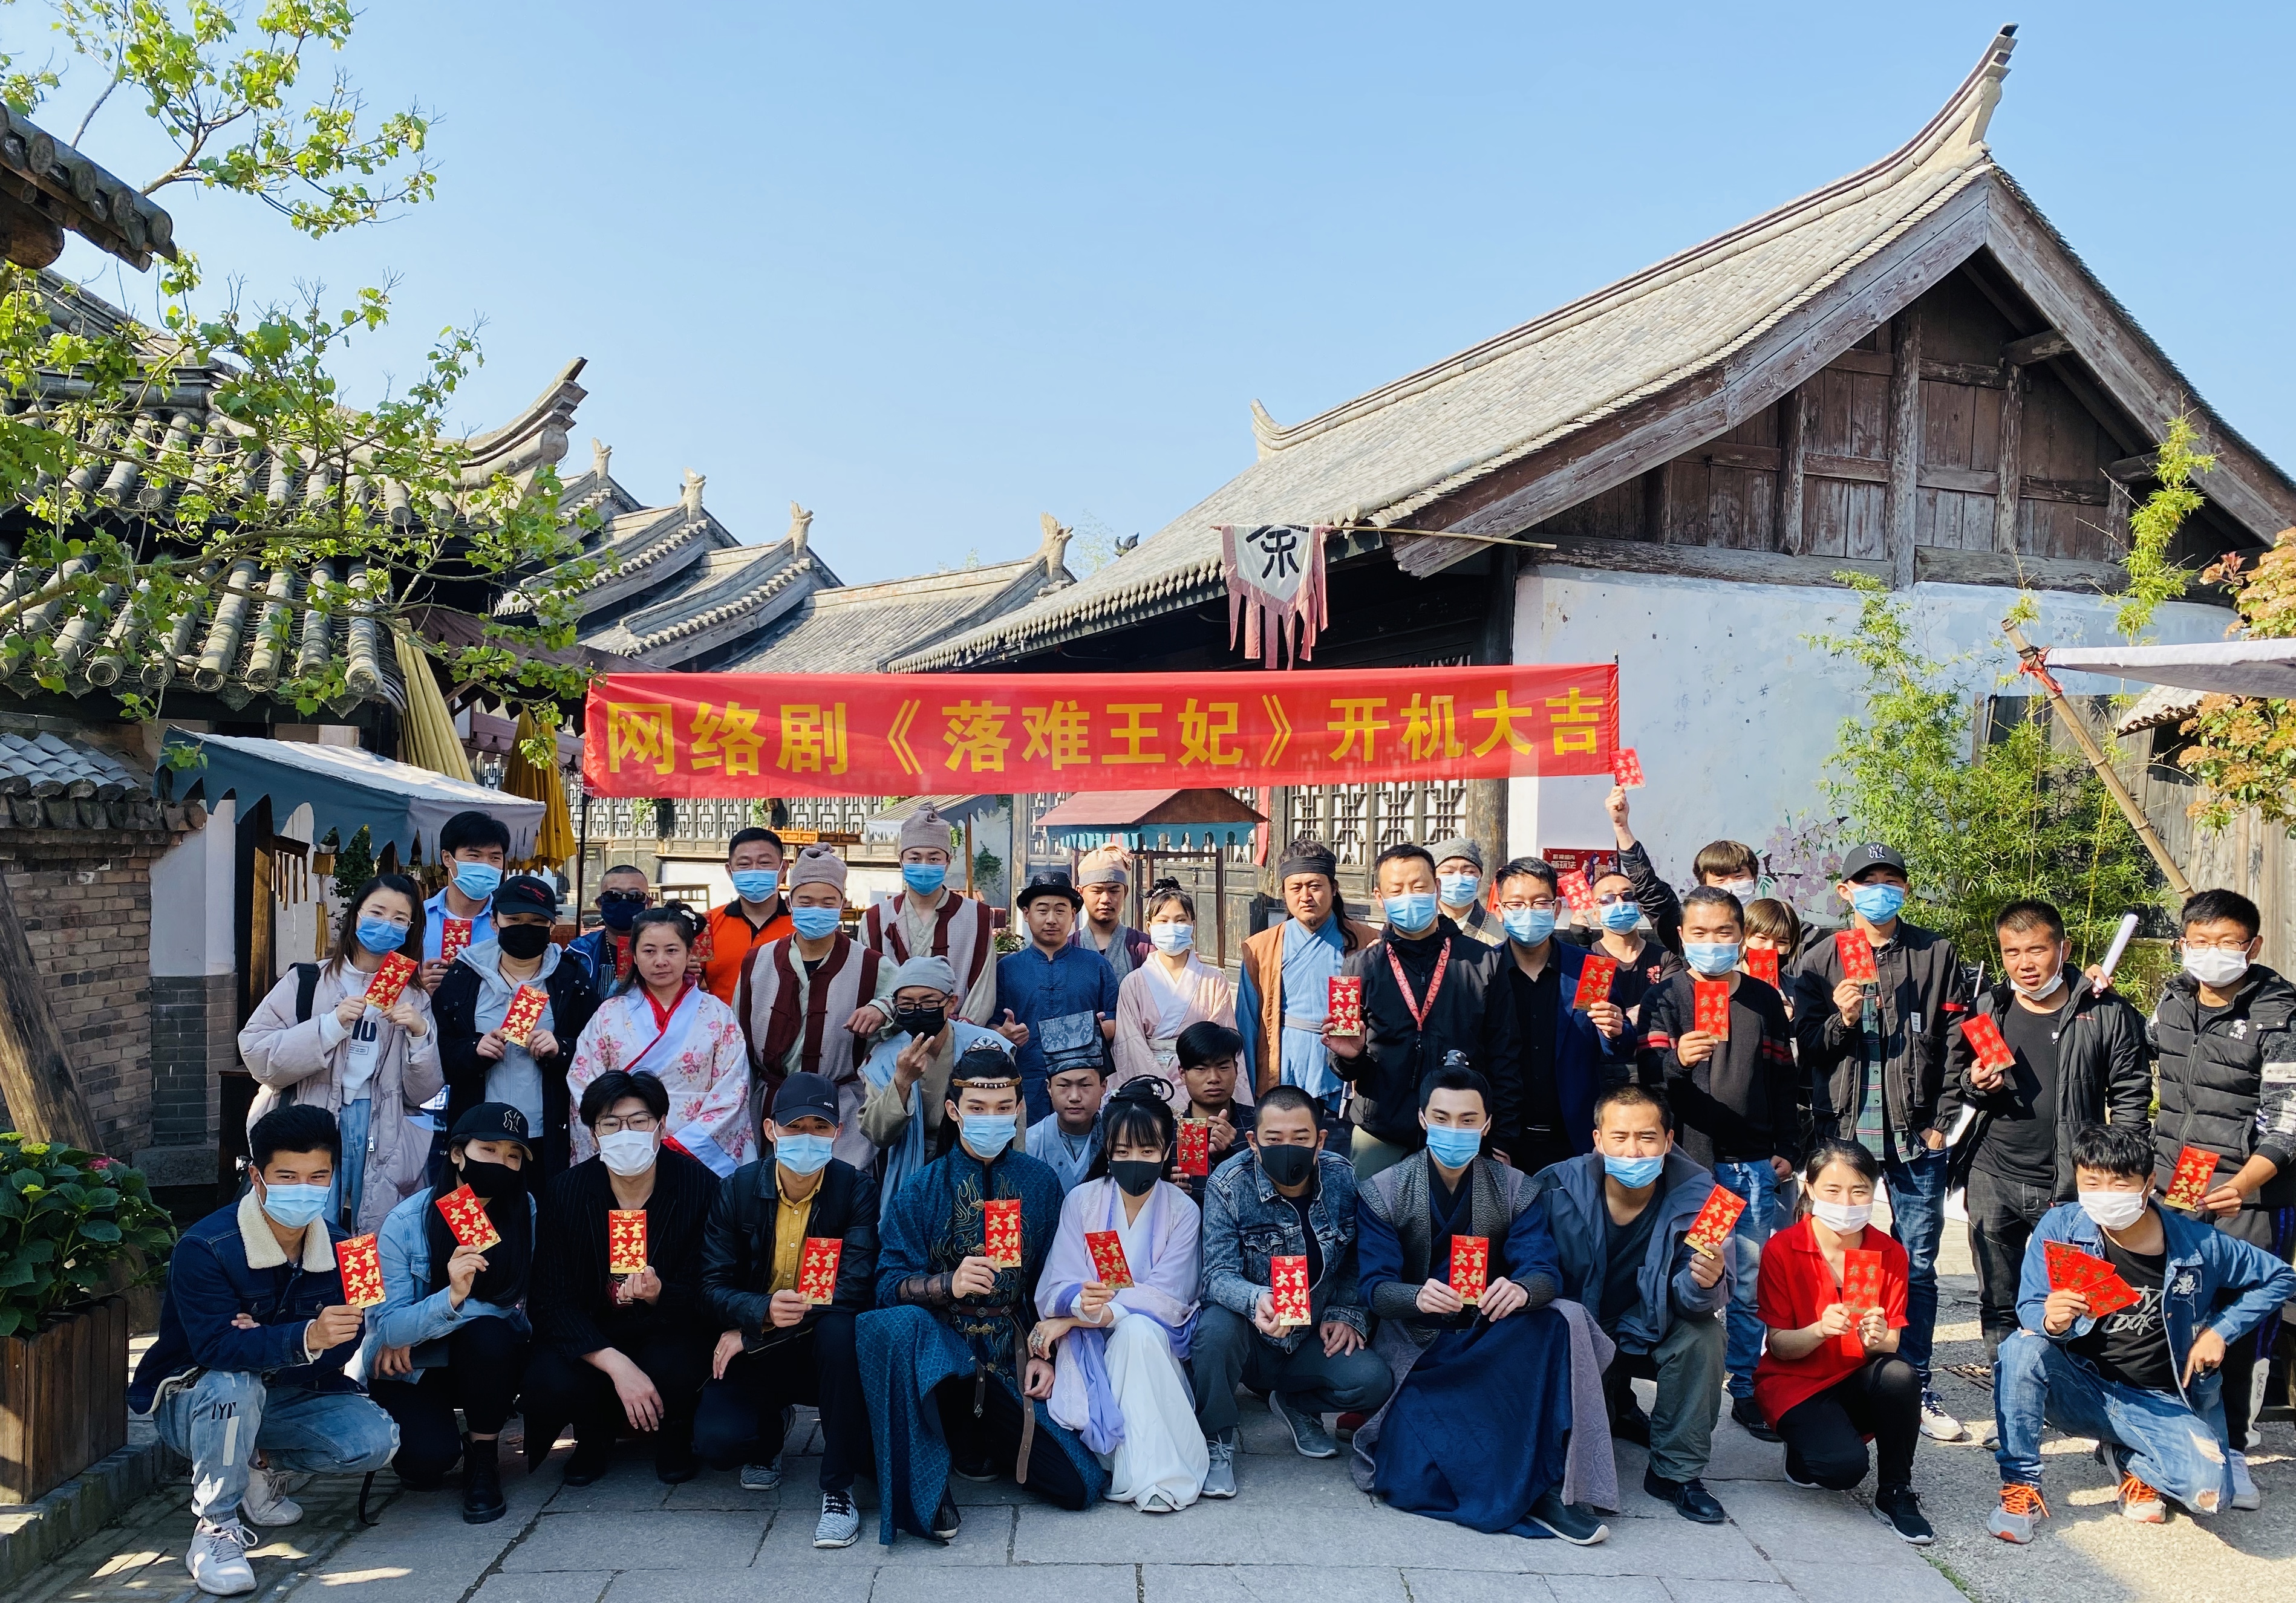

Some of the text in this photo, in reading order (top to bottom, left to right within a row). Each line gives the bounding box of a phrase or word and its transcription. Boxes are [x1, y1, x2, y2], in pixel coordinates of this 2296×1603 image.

[607, 688, 1604, 776] 网络剧《落难王妃》开机大吉
[612, 1222, 644, 1239] 大吉
[612, 1240, 644, 1256] 大利
[806, 1251, 838, 1268] 大吉
[803, 1270, 835, 1286] 大利
[1276, 1269, 1306, 1287] 大吉
[1277, 1288, 1307, 1306] 大利
